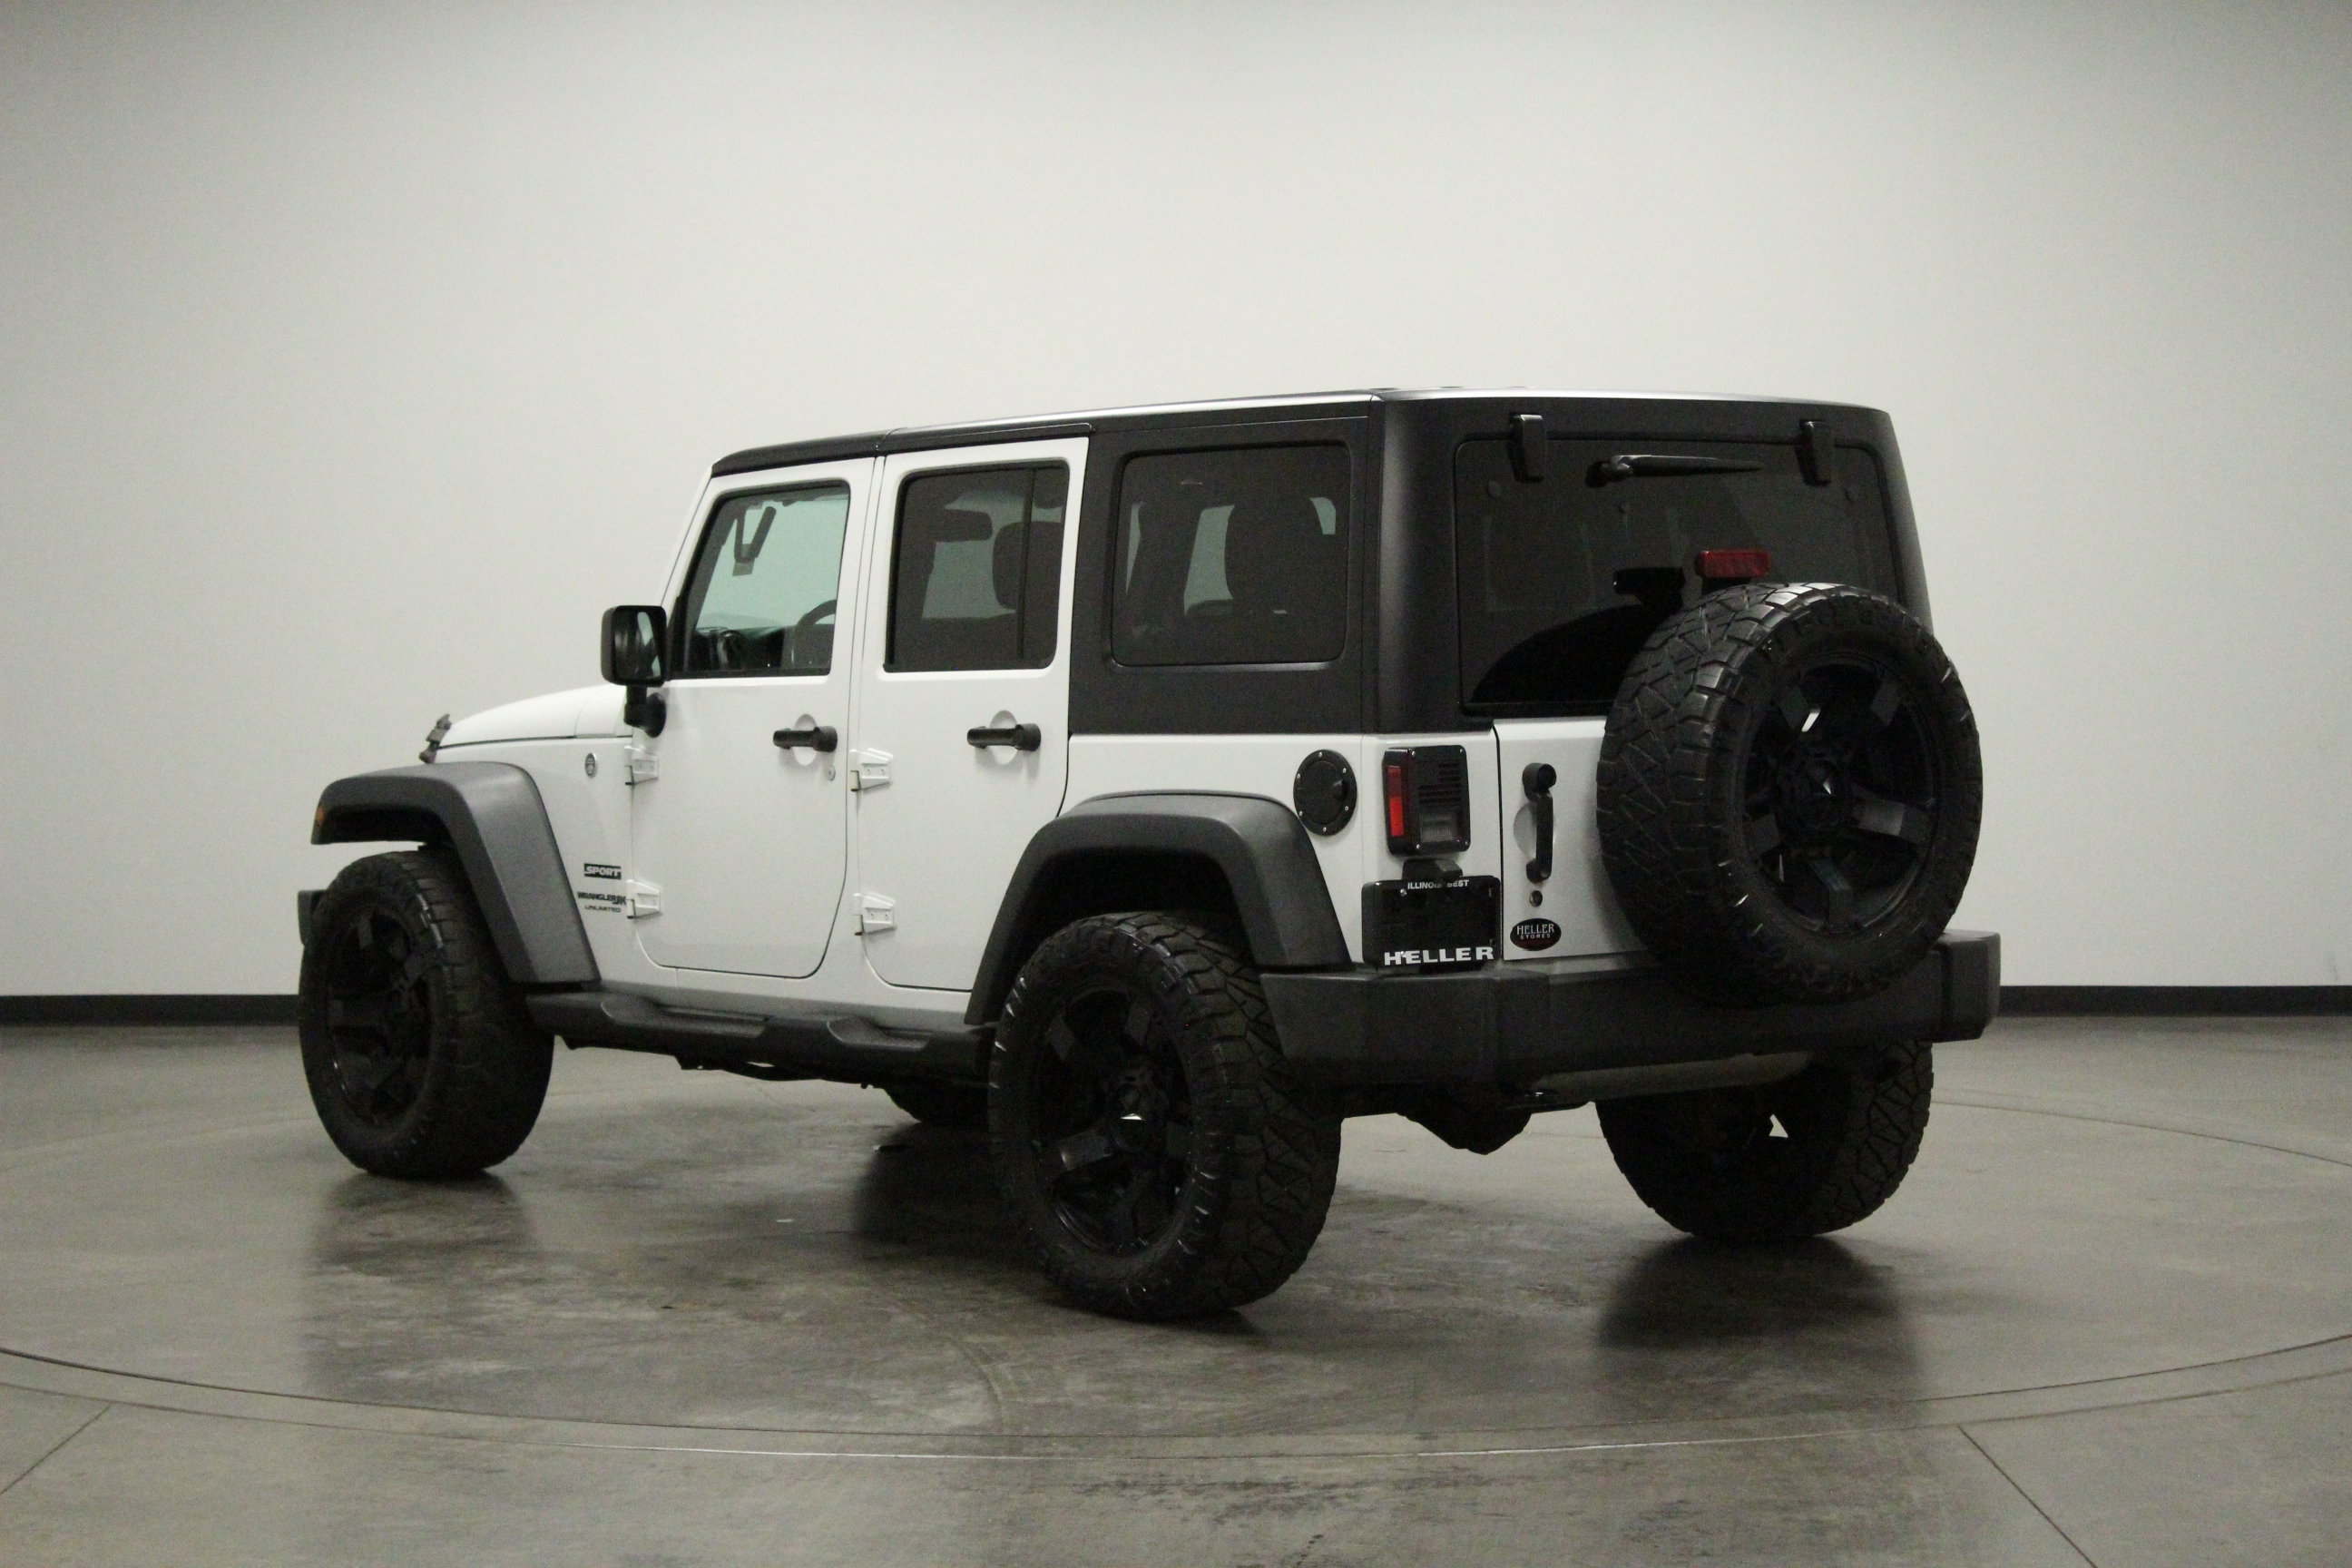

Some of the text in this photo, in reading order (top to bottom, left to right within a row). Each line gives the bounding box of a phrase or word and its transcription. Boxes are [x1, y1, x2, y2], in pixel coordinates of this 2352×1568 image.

[584, 865, 622, 877] SPORT
[1446, 879, 1469, 888] BEST
[1516, 924, 1554, 935] HELLER
[1384, 946, 1494, 965] HELLER
